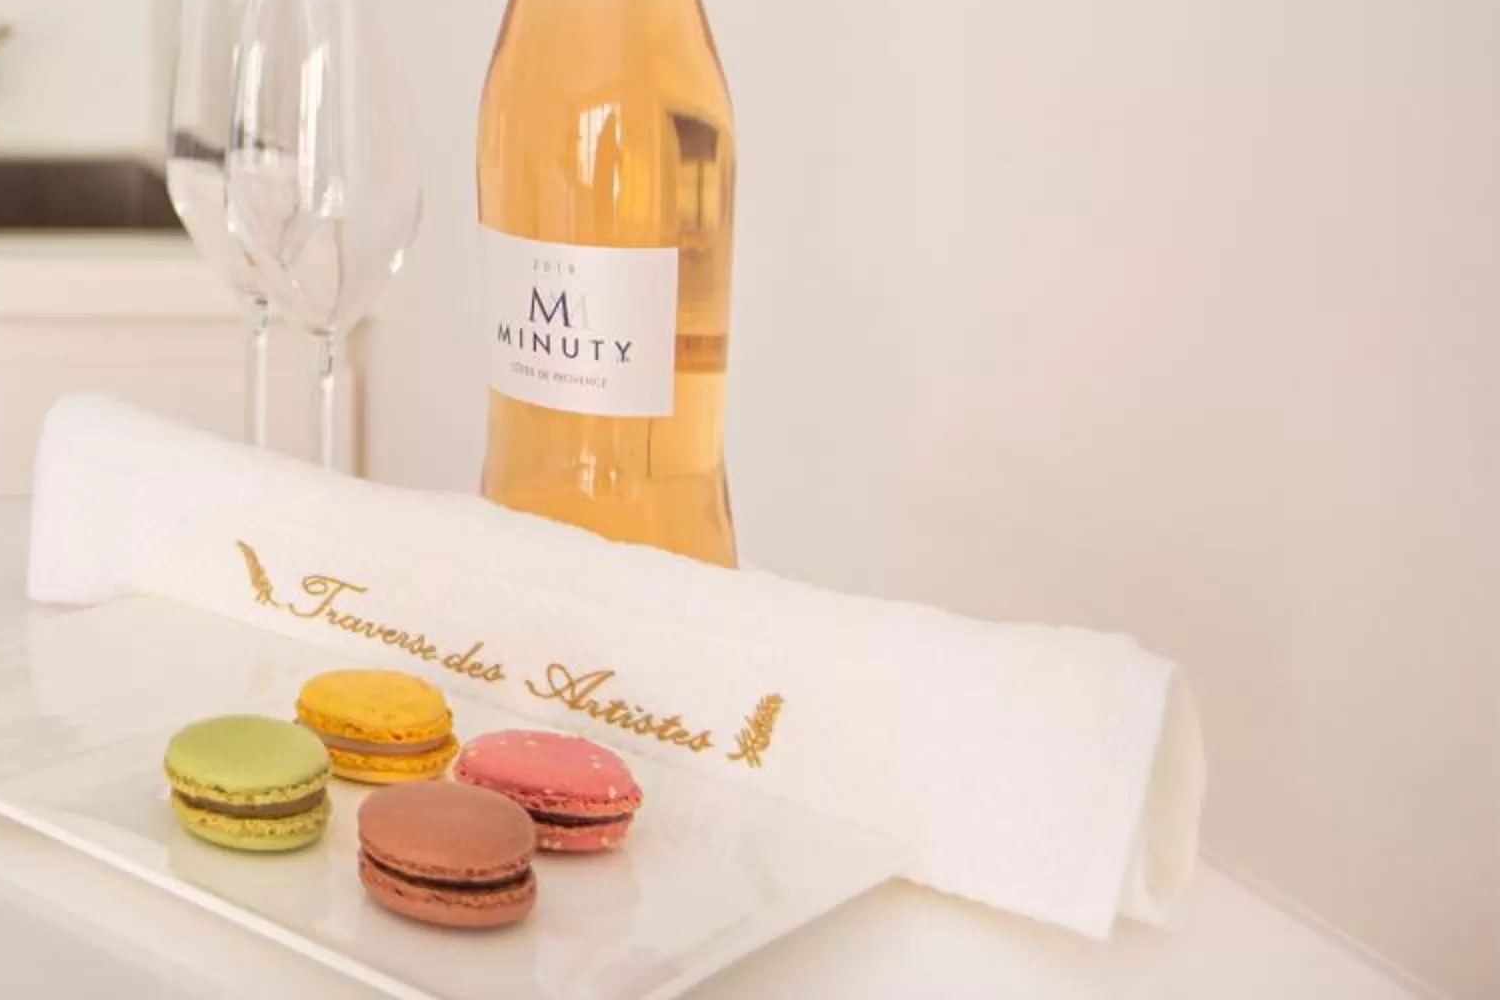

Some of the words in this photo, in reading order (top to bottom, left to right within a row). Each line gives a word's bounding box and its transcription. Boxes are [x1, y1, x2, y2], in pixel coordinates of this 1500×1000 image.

[497, 323, 633, 363] MINUTY
[288, 574, 437, 661] Traverse
[441, 641, 506, 684] des
[524, 663, 715, 753] Artistes
